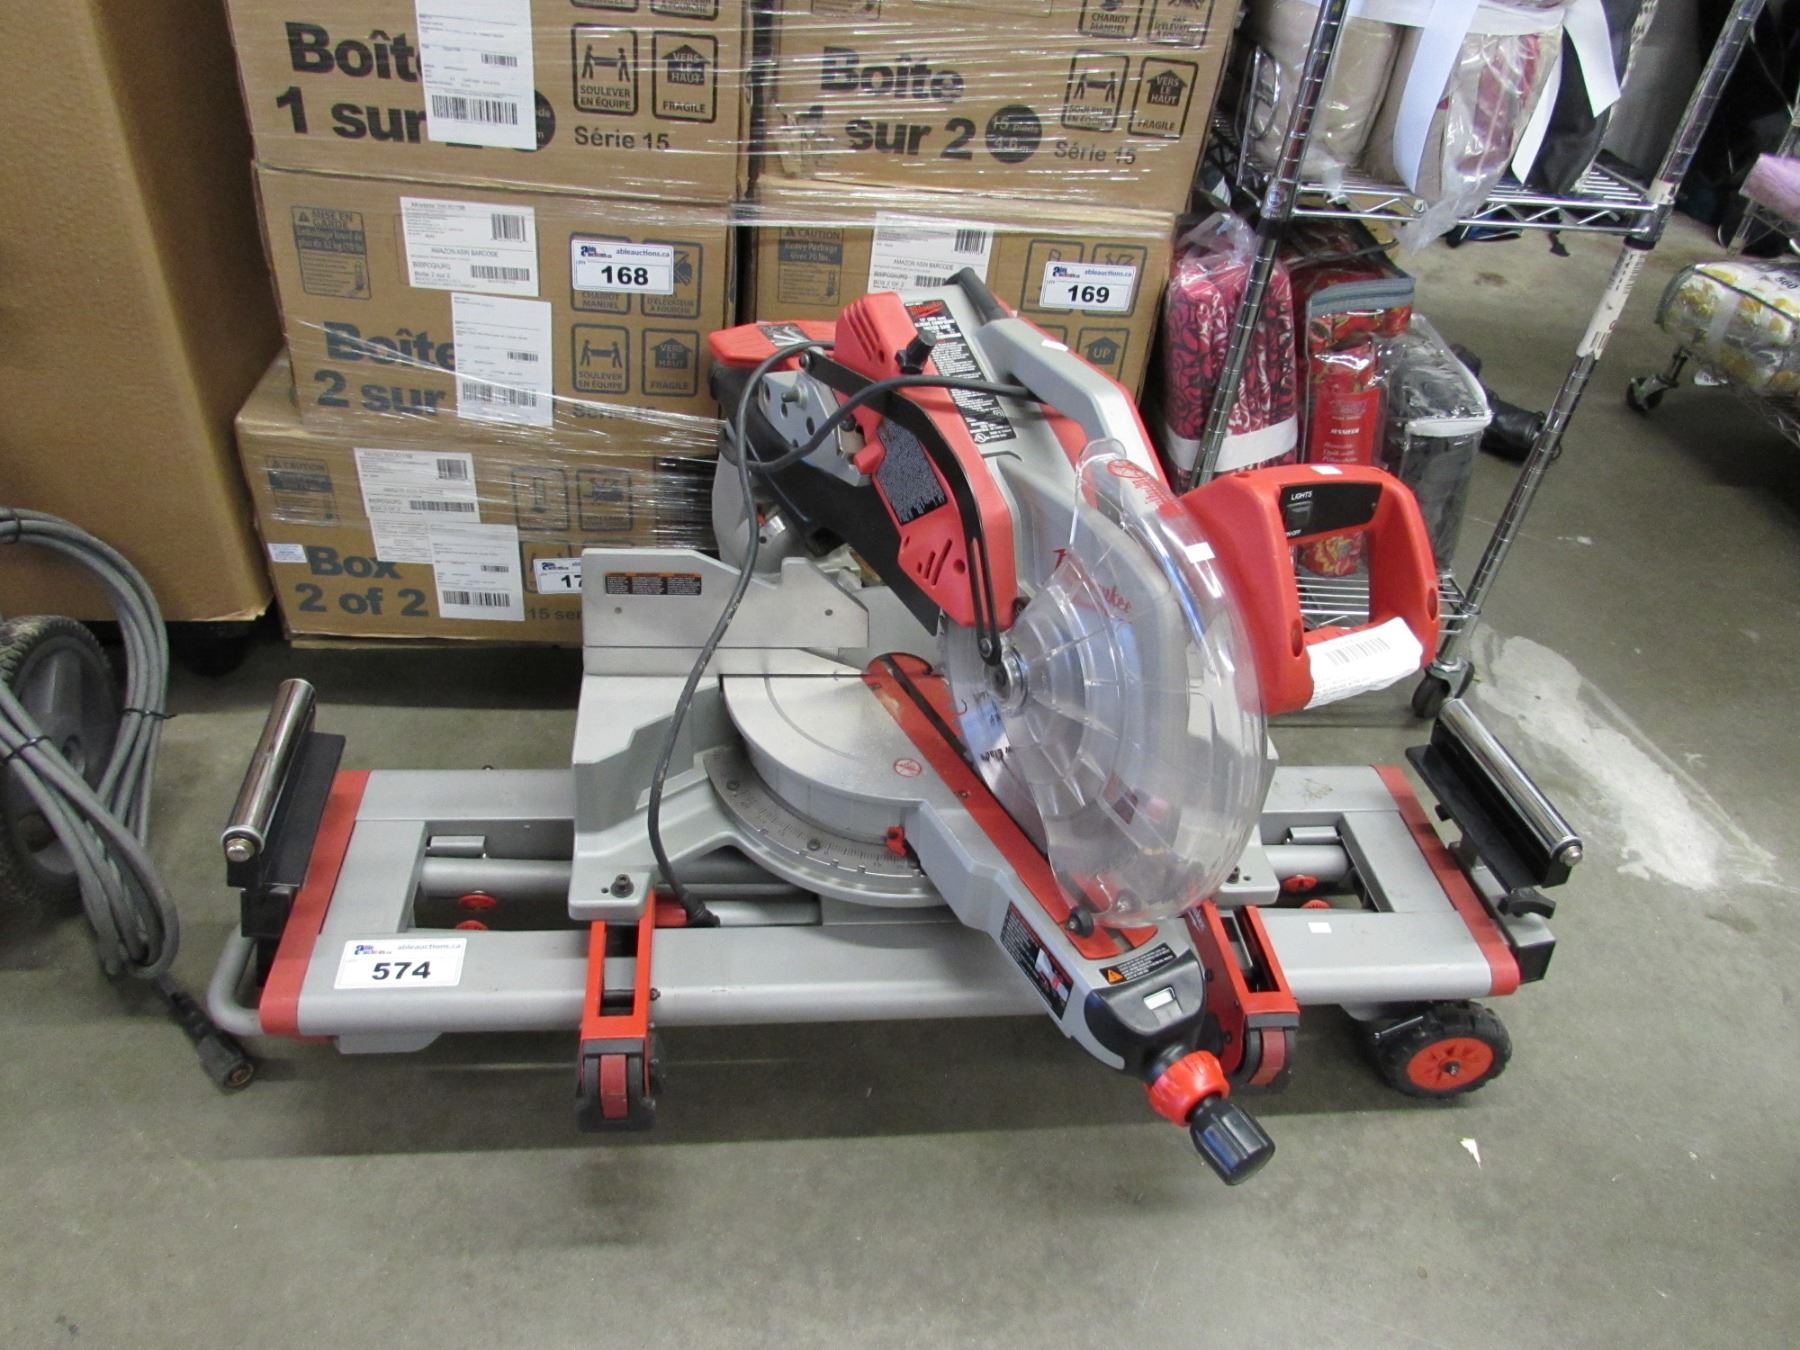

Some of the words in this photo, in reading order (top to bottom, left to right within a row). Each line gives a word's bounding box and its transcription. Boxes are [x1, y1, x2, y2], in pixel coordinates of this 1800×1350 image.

[285, 21, 421, 82] Boît
[673, 52, 699, 63] VERS
[1156, 77, 1179, 87] VERS
[580, 85, 631, 98] SOULEVER
[1160, 85, 1171, 95] LE
[580, 97, 593, 107] EN
[1151, 93, 1178, 104] HAUT
[663, 100, 706, 114] FRAGILE
[276, 86, 308, 134] 1
[331, 103, 426, 144] sur
[1137, 119, 1176, 131] FRAGILE
[574, 126, 635, 149] Série
[643, 133, 670, 150] 15
[845, 119, 932, 155] sur
[940, 117, 976, 160] 2
[1053, 140, 1107, 162] Série
[616, 248, 670, 258] ableauctions.ca
[601, 265, 649, 285] 168
[1068, 284, 1110, 304] 169
[1093, 346, 1109, 358] UP
[314, 369, 349, 407] 2
[360, 383, 445, 416] sur
[1291, 490, 1313, 501] LIGHTS
[306, 545, 401, 579] Box
[295, 583, 328, 612] 2
[338, 587, 385, 615] of
[398, 588, 431, 617] 2
[527, 608, 550, 620] 15
[372, 961, 431, 980] 574
